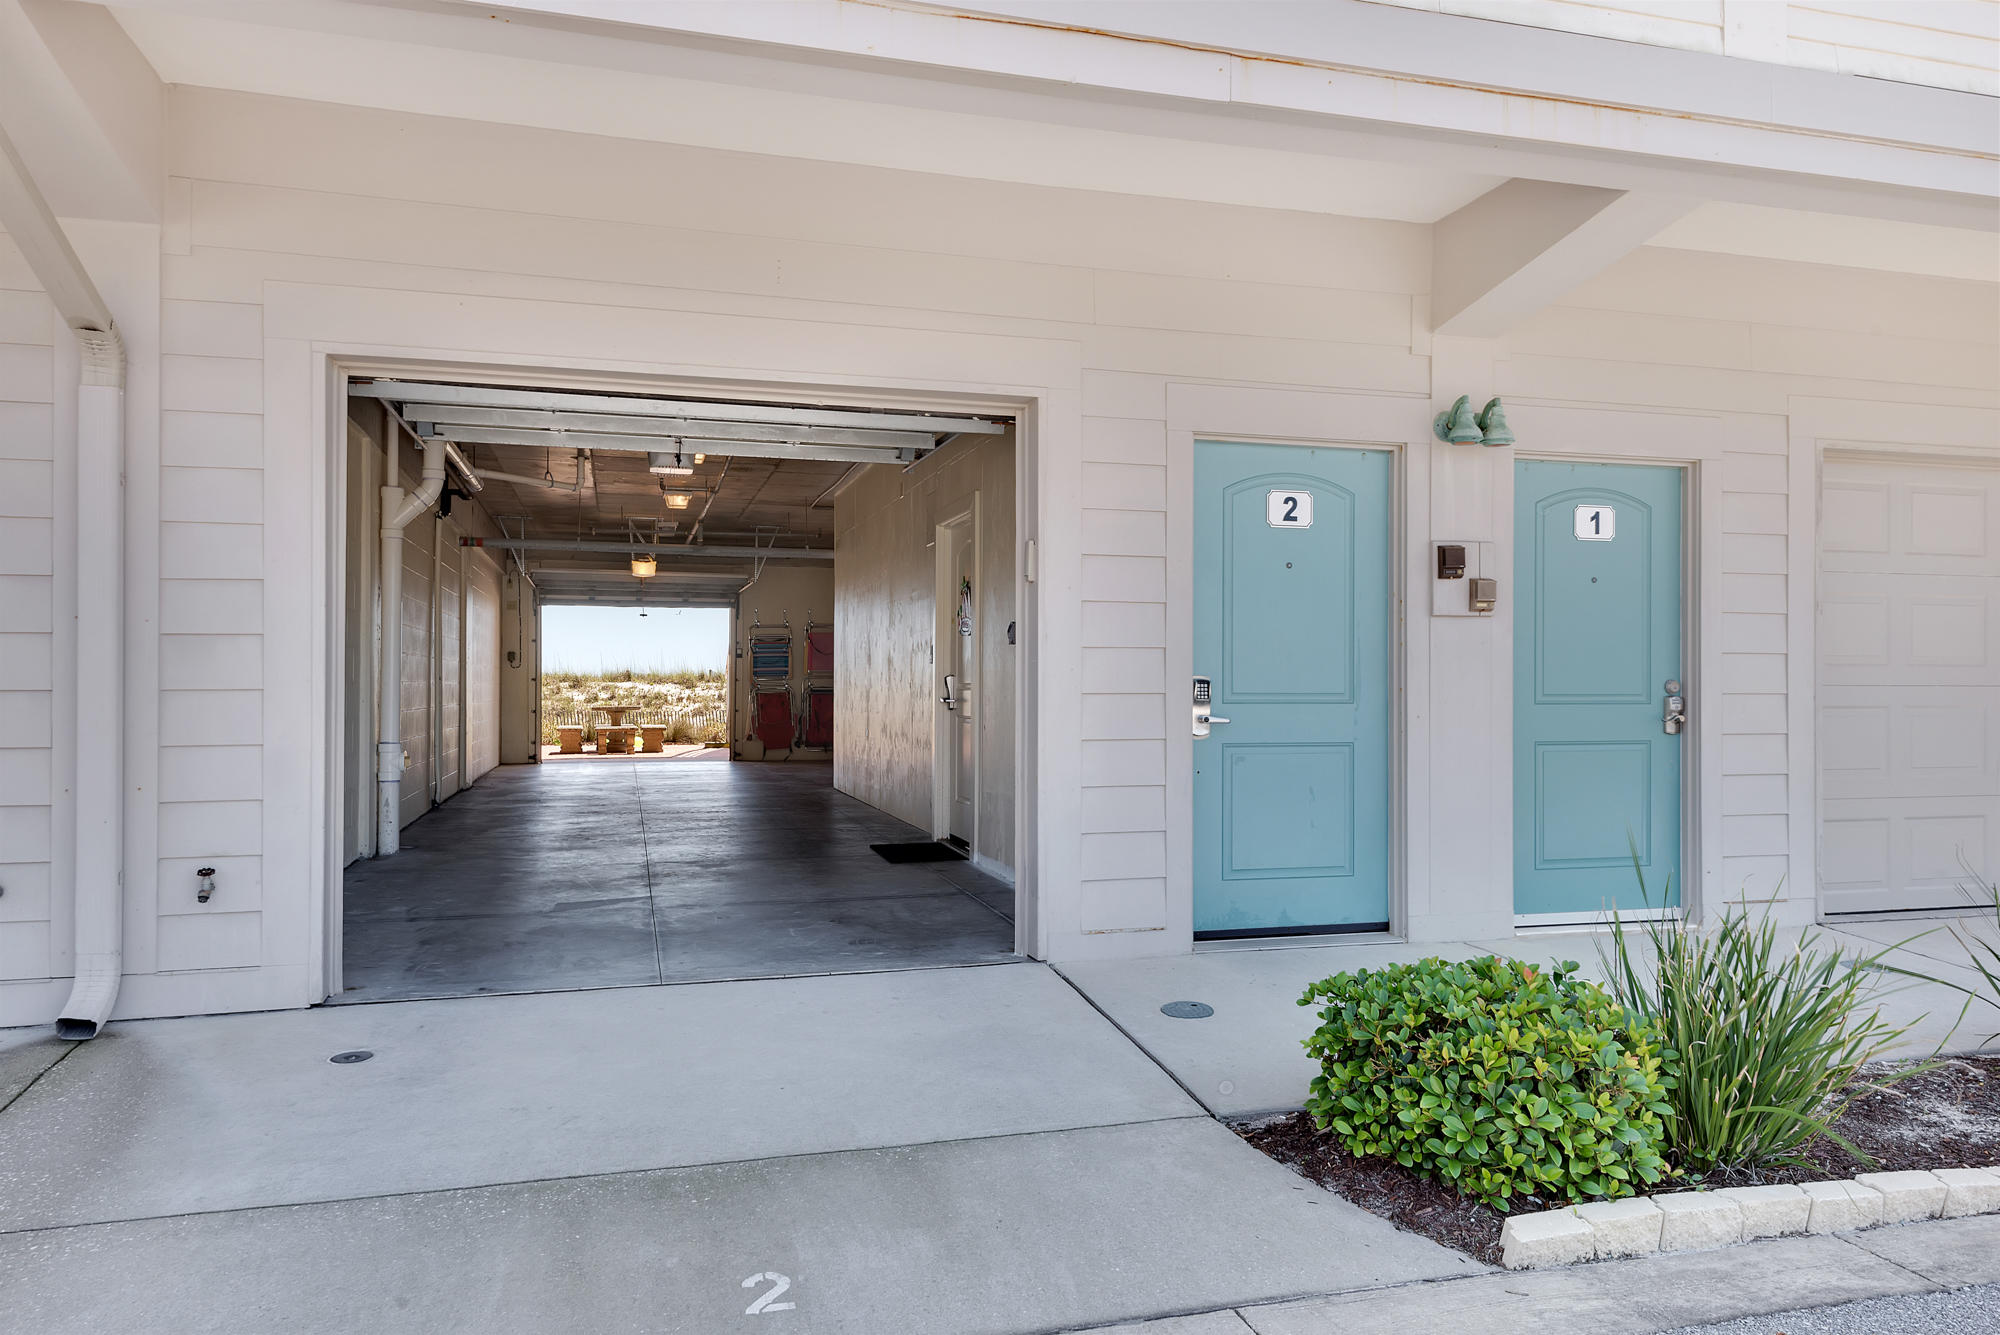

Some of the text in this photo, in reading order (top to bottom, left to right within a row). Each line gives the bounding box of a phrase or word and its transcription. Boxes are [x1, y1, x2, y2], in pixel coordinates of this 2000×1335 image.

[1282, 496, 1298, 522] 2
[1590, 511, 1600, 535] 1
[741, 1271, 796, 1315] 2
